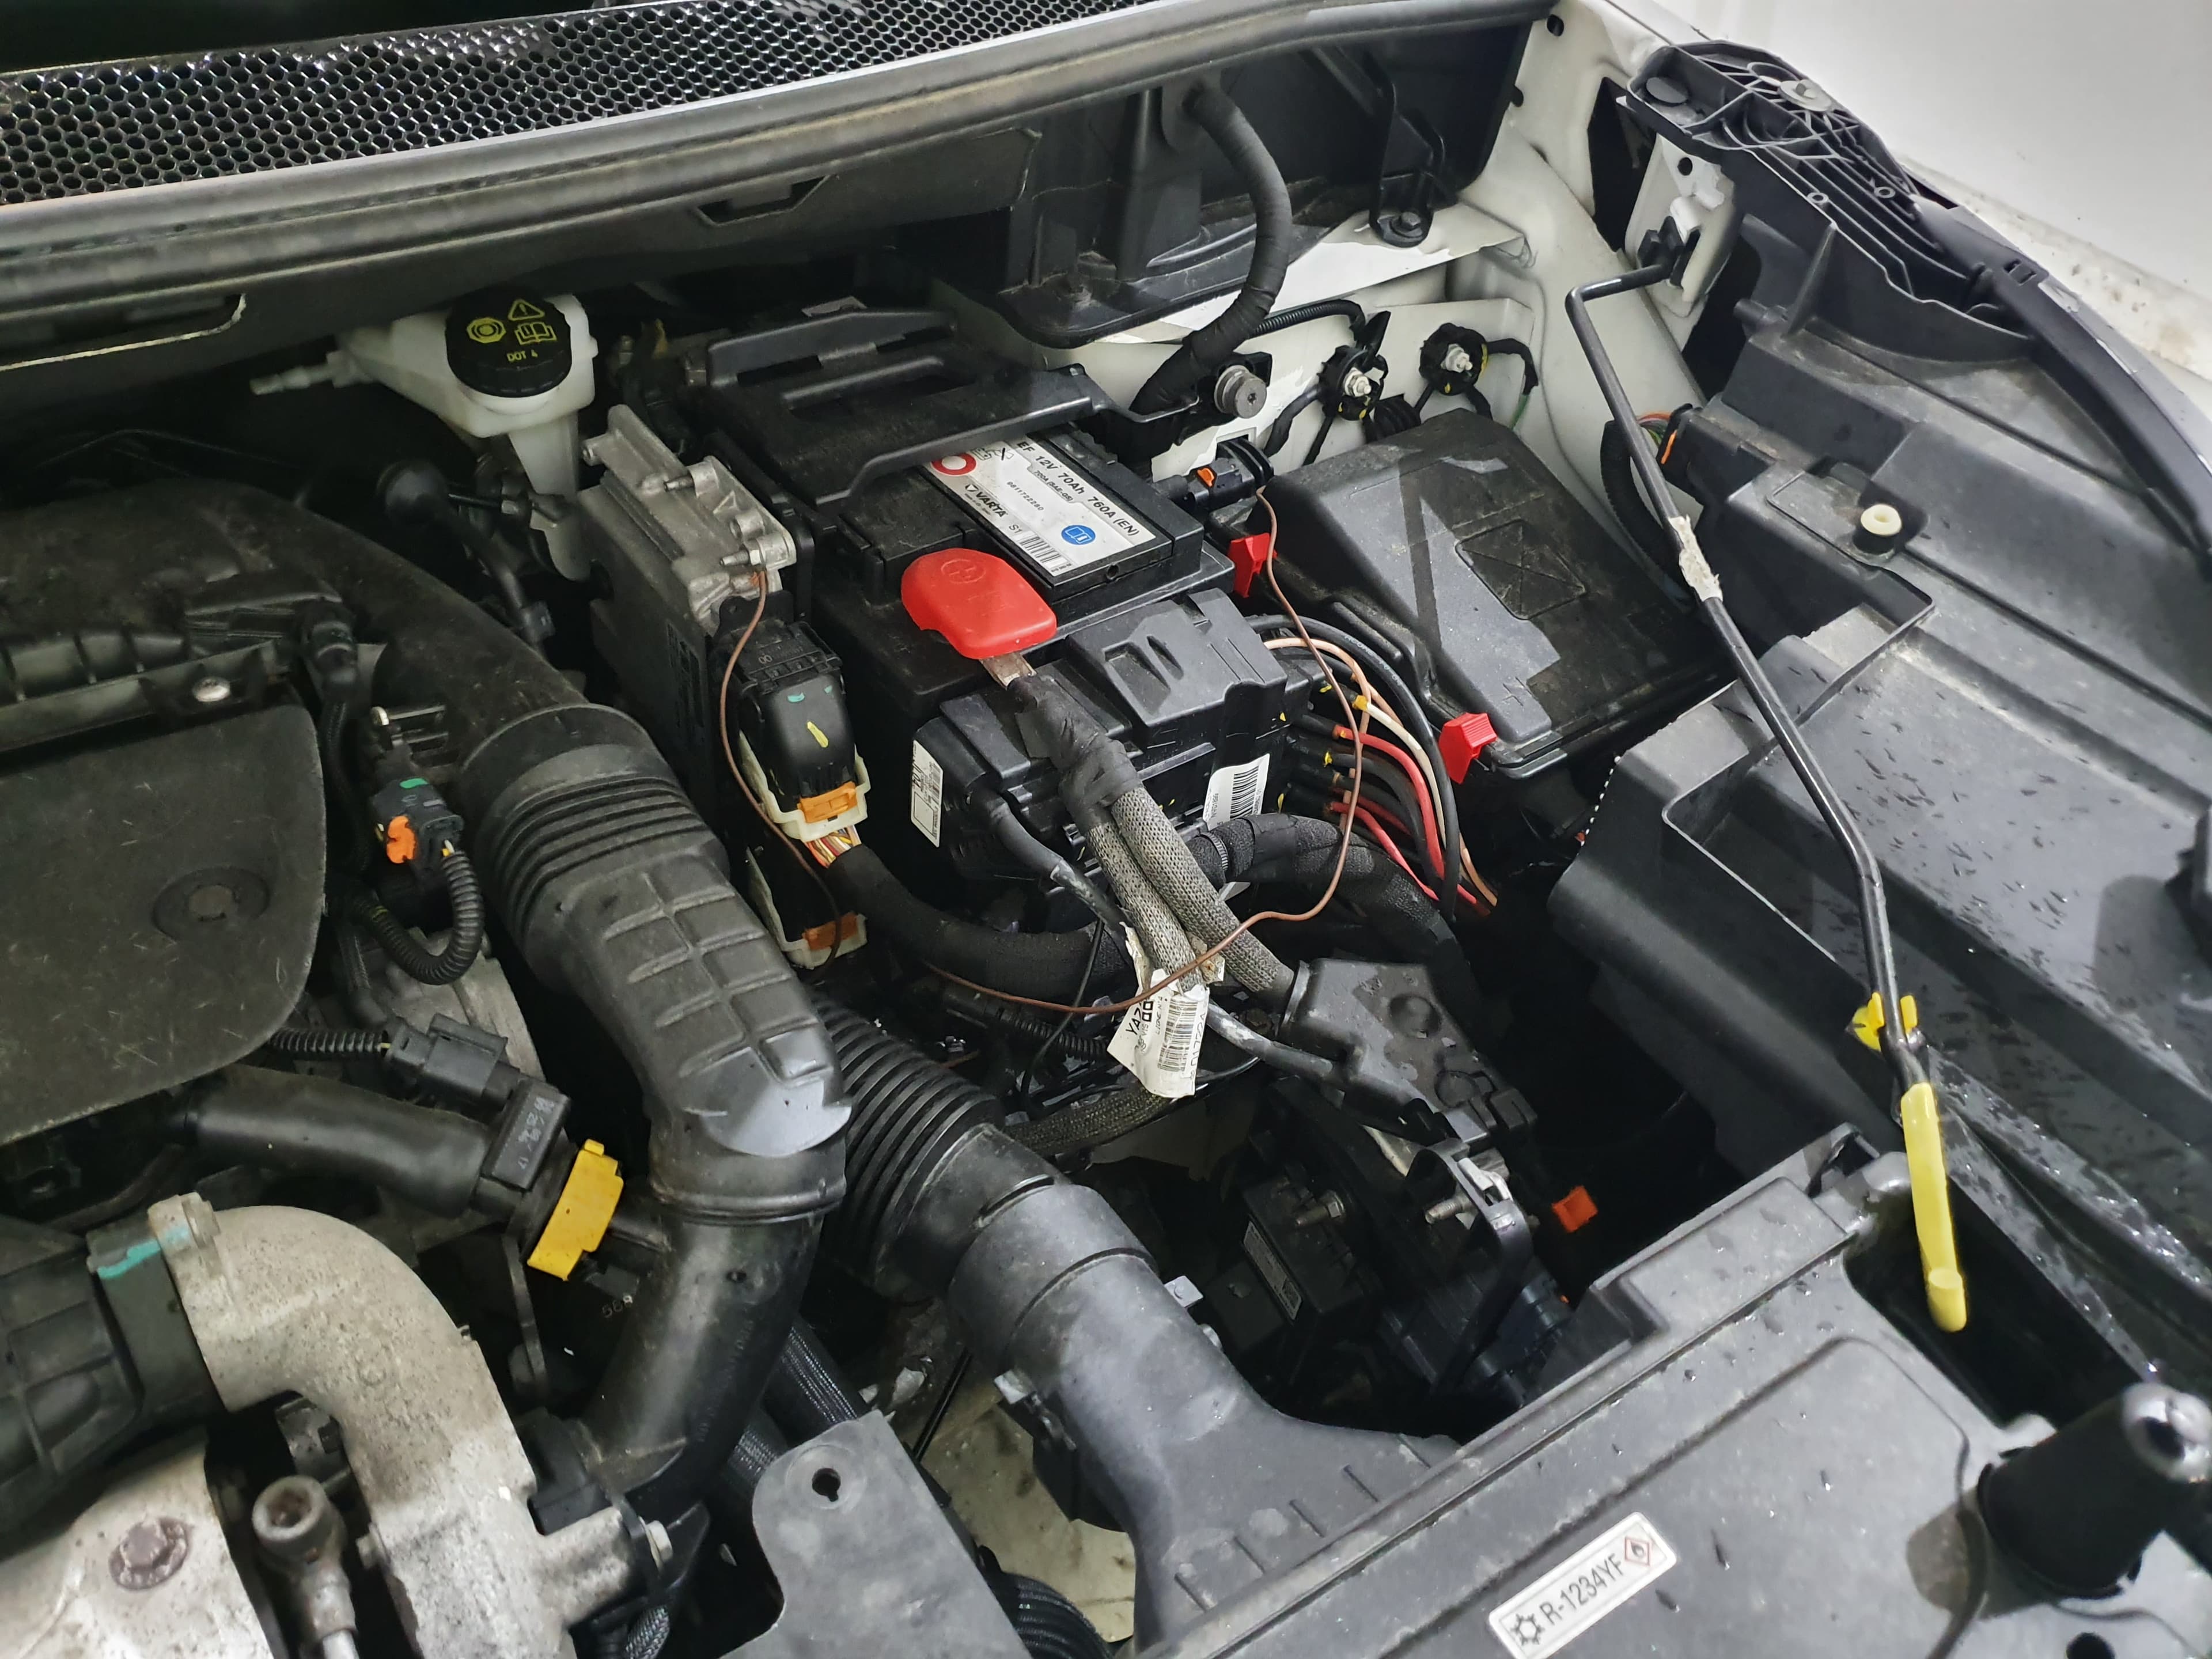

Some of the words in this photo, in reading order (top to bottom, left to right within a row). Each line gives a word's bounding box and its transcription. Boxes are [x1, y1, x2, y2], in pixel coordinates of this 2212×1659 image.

[507, 350, 527, 363] DOT
[976, 491, 1007, 517] VARTA
[1036, 456, 1059, 469] 12V
[1058, 472, 1085, 494] 70Ah
[1088, 496, 1116, 518] 760A
[1112, 518, 1140, 536] (EN)
[1009, 524, 1023, 533] S1
[1539, 1553, 1623, 1625] R-1234YF
